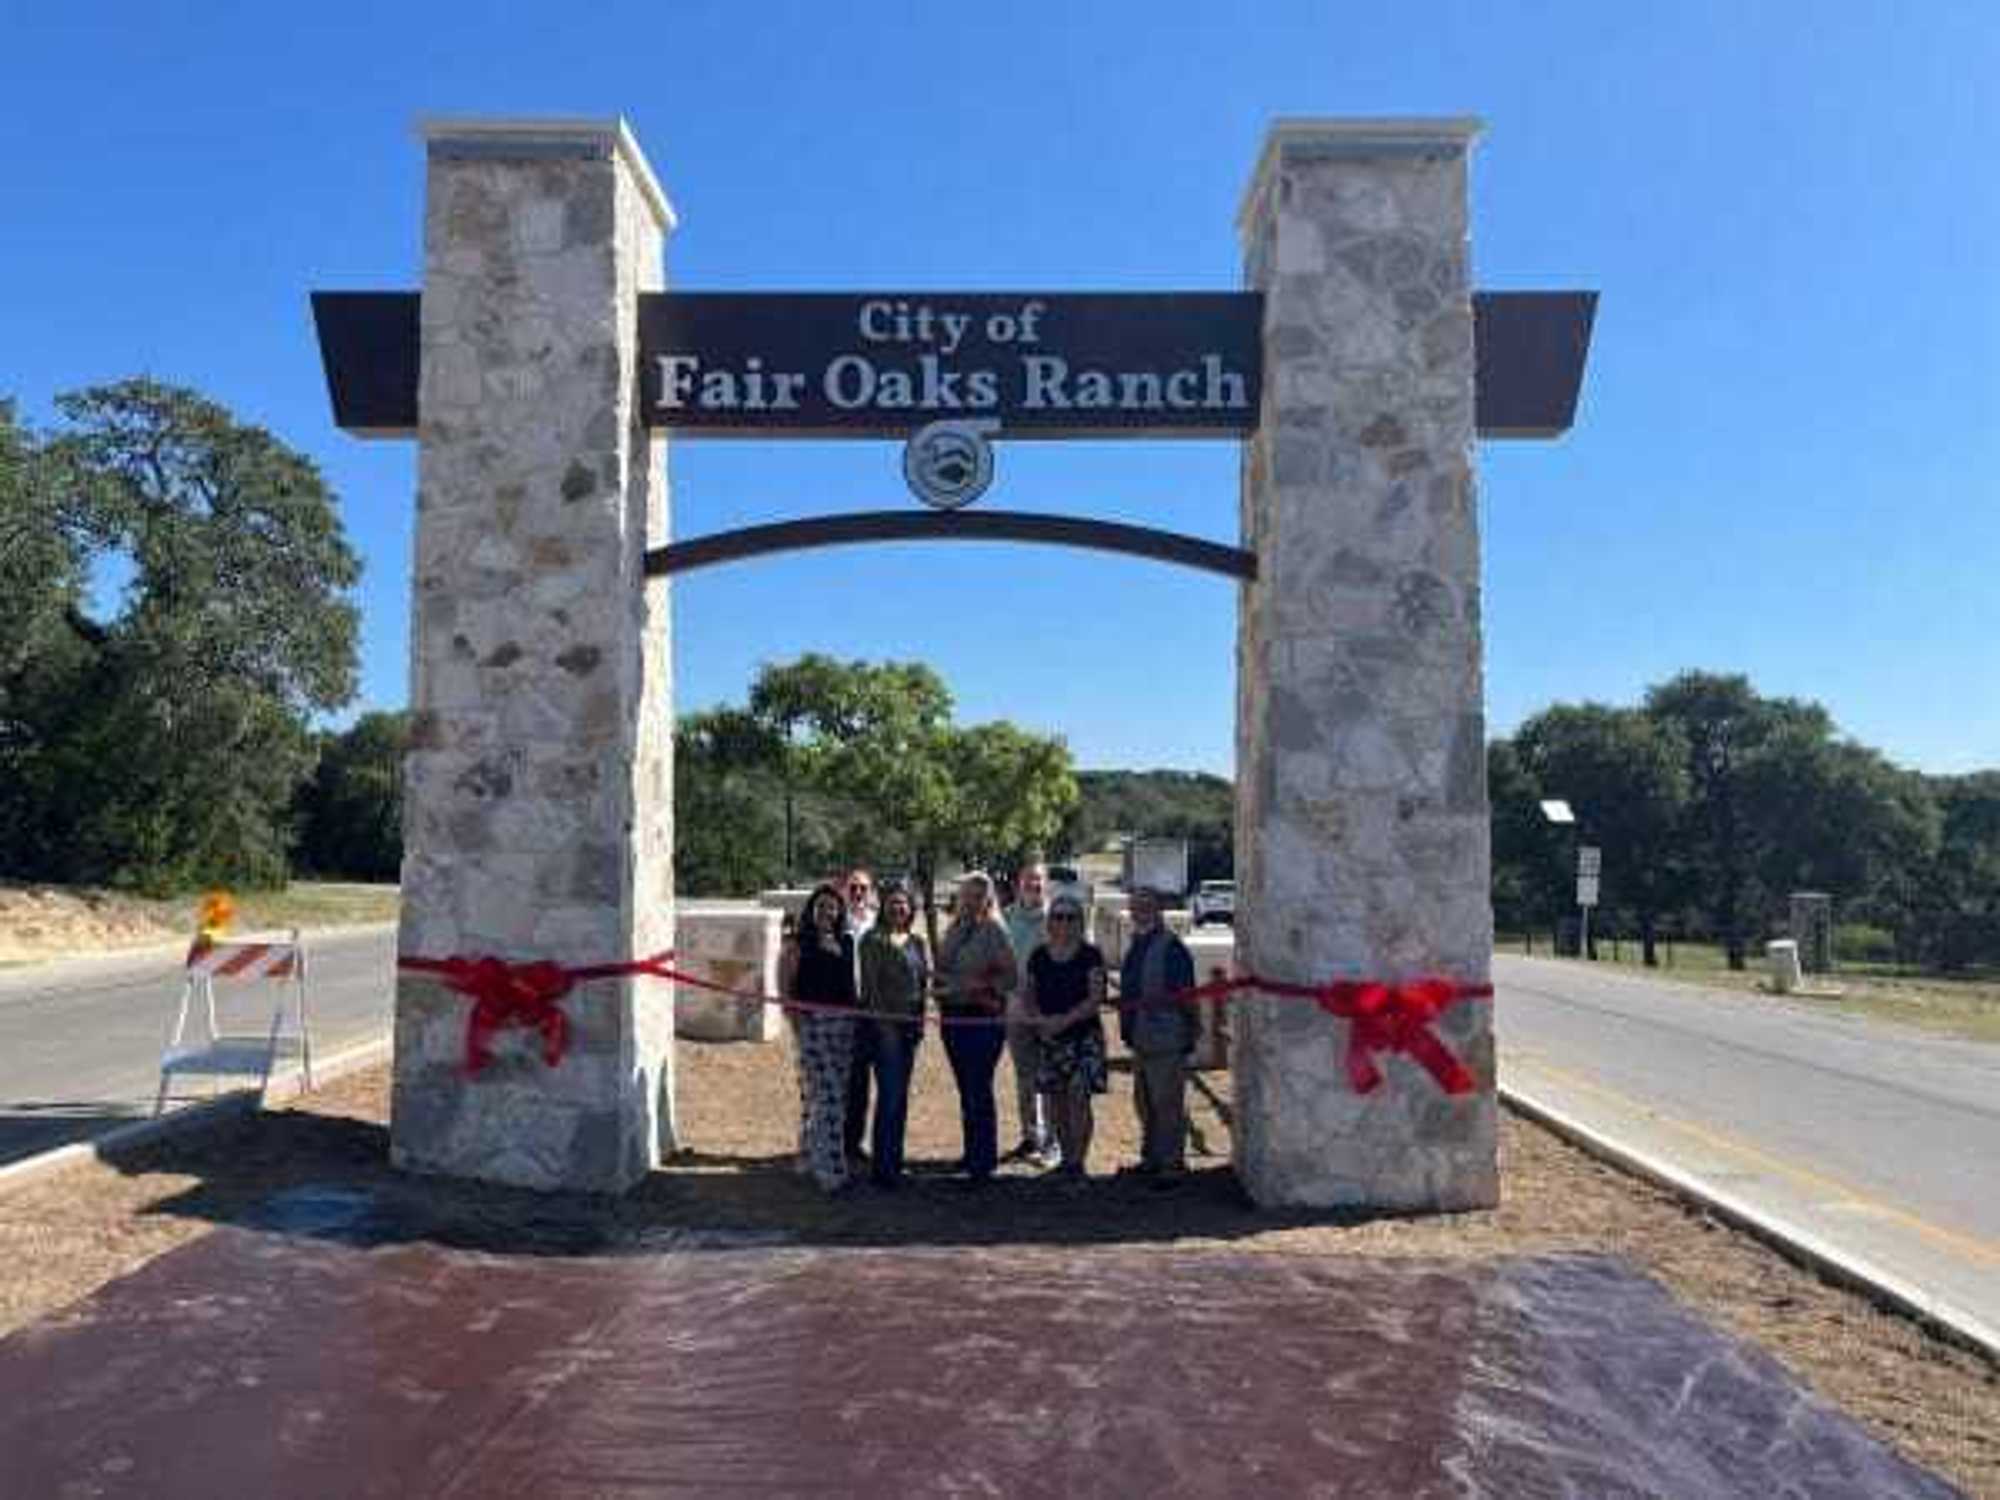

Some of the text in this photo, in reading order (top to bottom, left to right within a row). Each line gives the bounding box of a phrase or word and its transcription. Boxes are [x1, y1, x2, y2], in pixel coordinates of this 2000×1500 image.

[860, 301, 1046, 353] City of
[655, 354, 1247, 410] Fair Oaks Ranch
